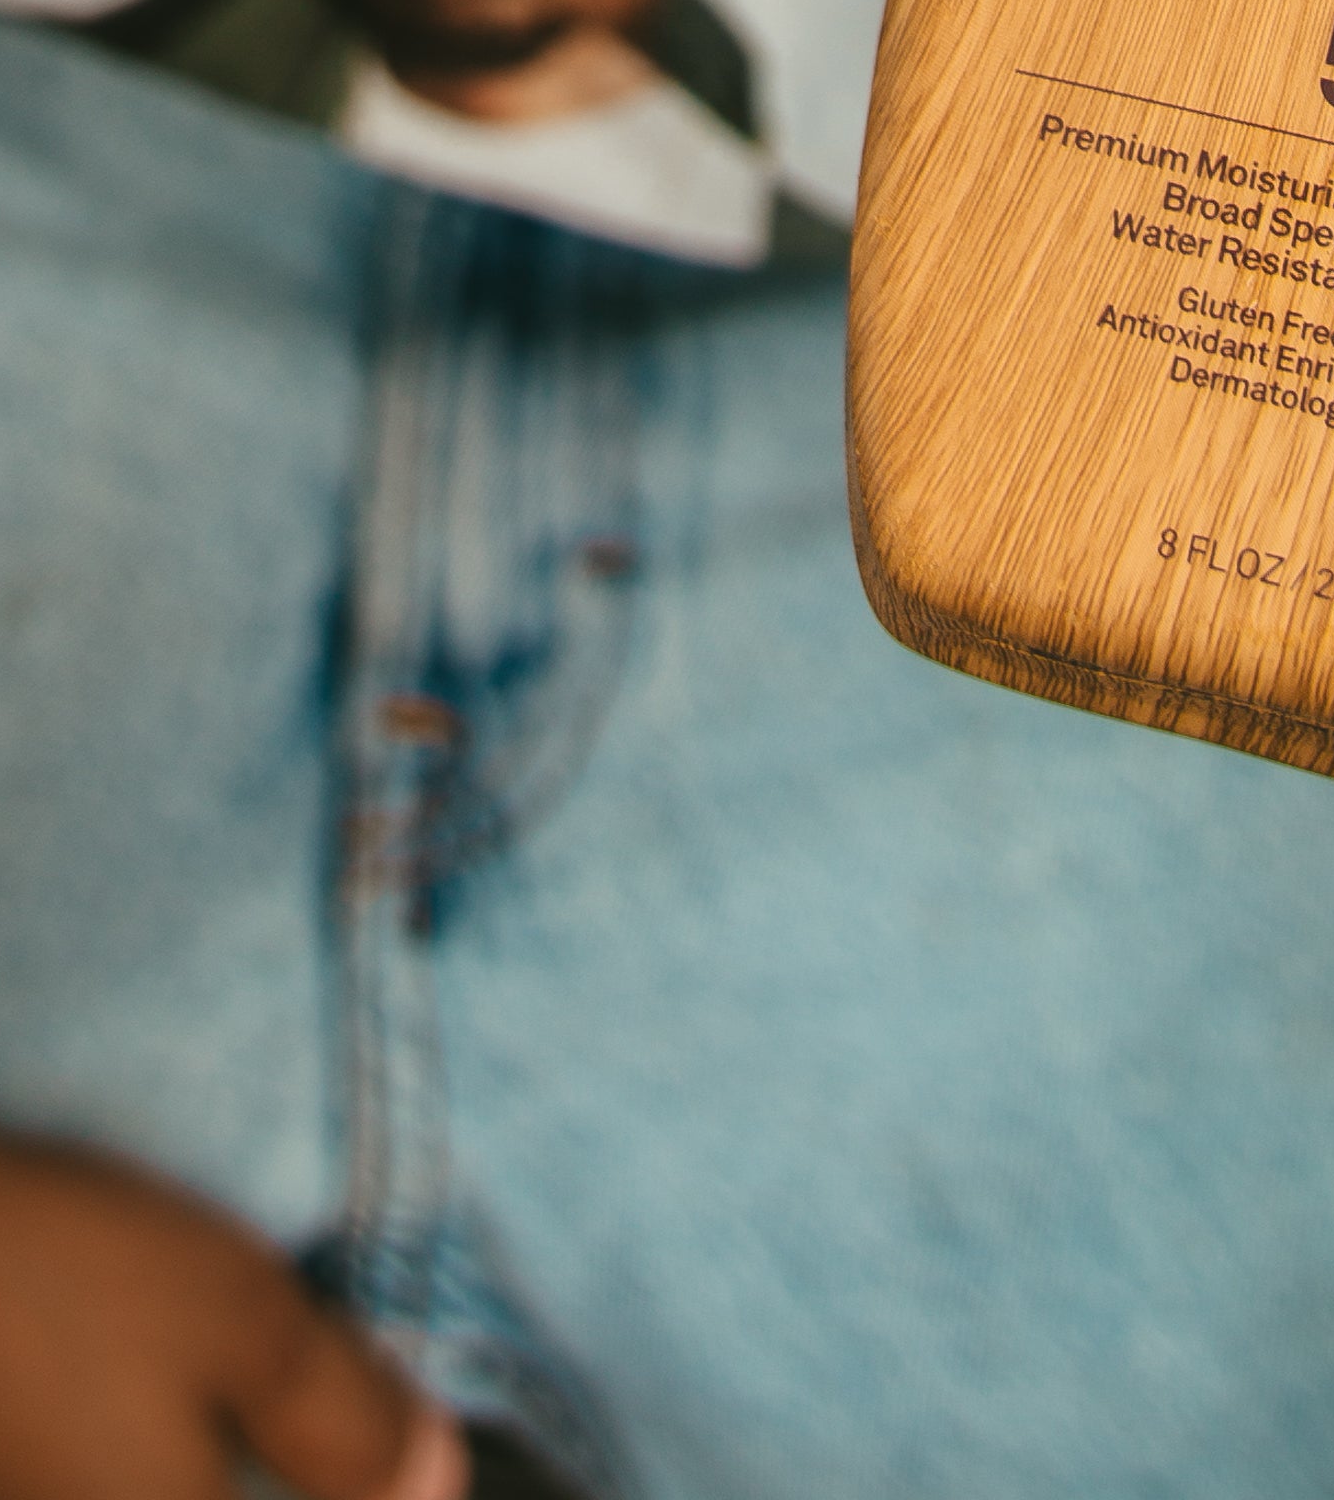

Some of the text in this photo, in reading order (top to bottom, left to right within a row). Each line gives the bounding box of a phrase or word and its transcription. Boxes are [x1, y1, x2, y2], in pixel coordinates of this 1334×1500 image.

[1038, 114, 1189, 173] Premium
[1163, 183, 1262, 230] Broad
[1112, 209, 1212, 259] Water
[1097, 305, 1270, 366] Antioxidant
[1178, 286, 1275, 333] Gluten
[1158, 528, 1178, 559] 8
[1187, 534, 1230, 573] FL
[1236, 548, 1283, 588] OZ
